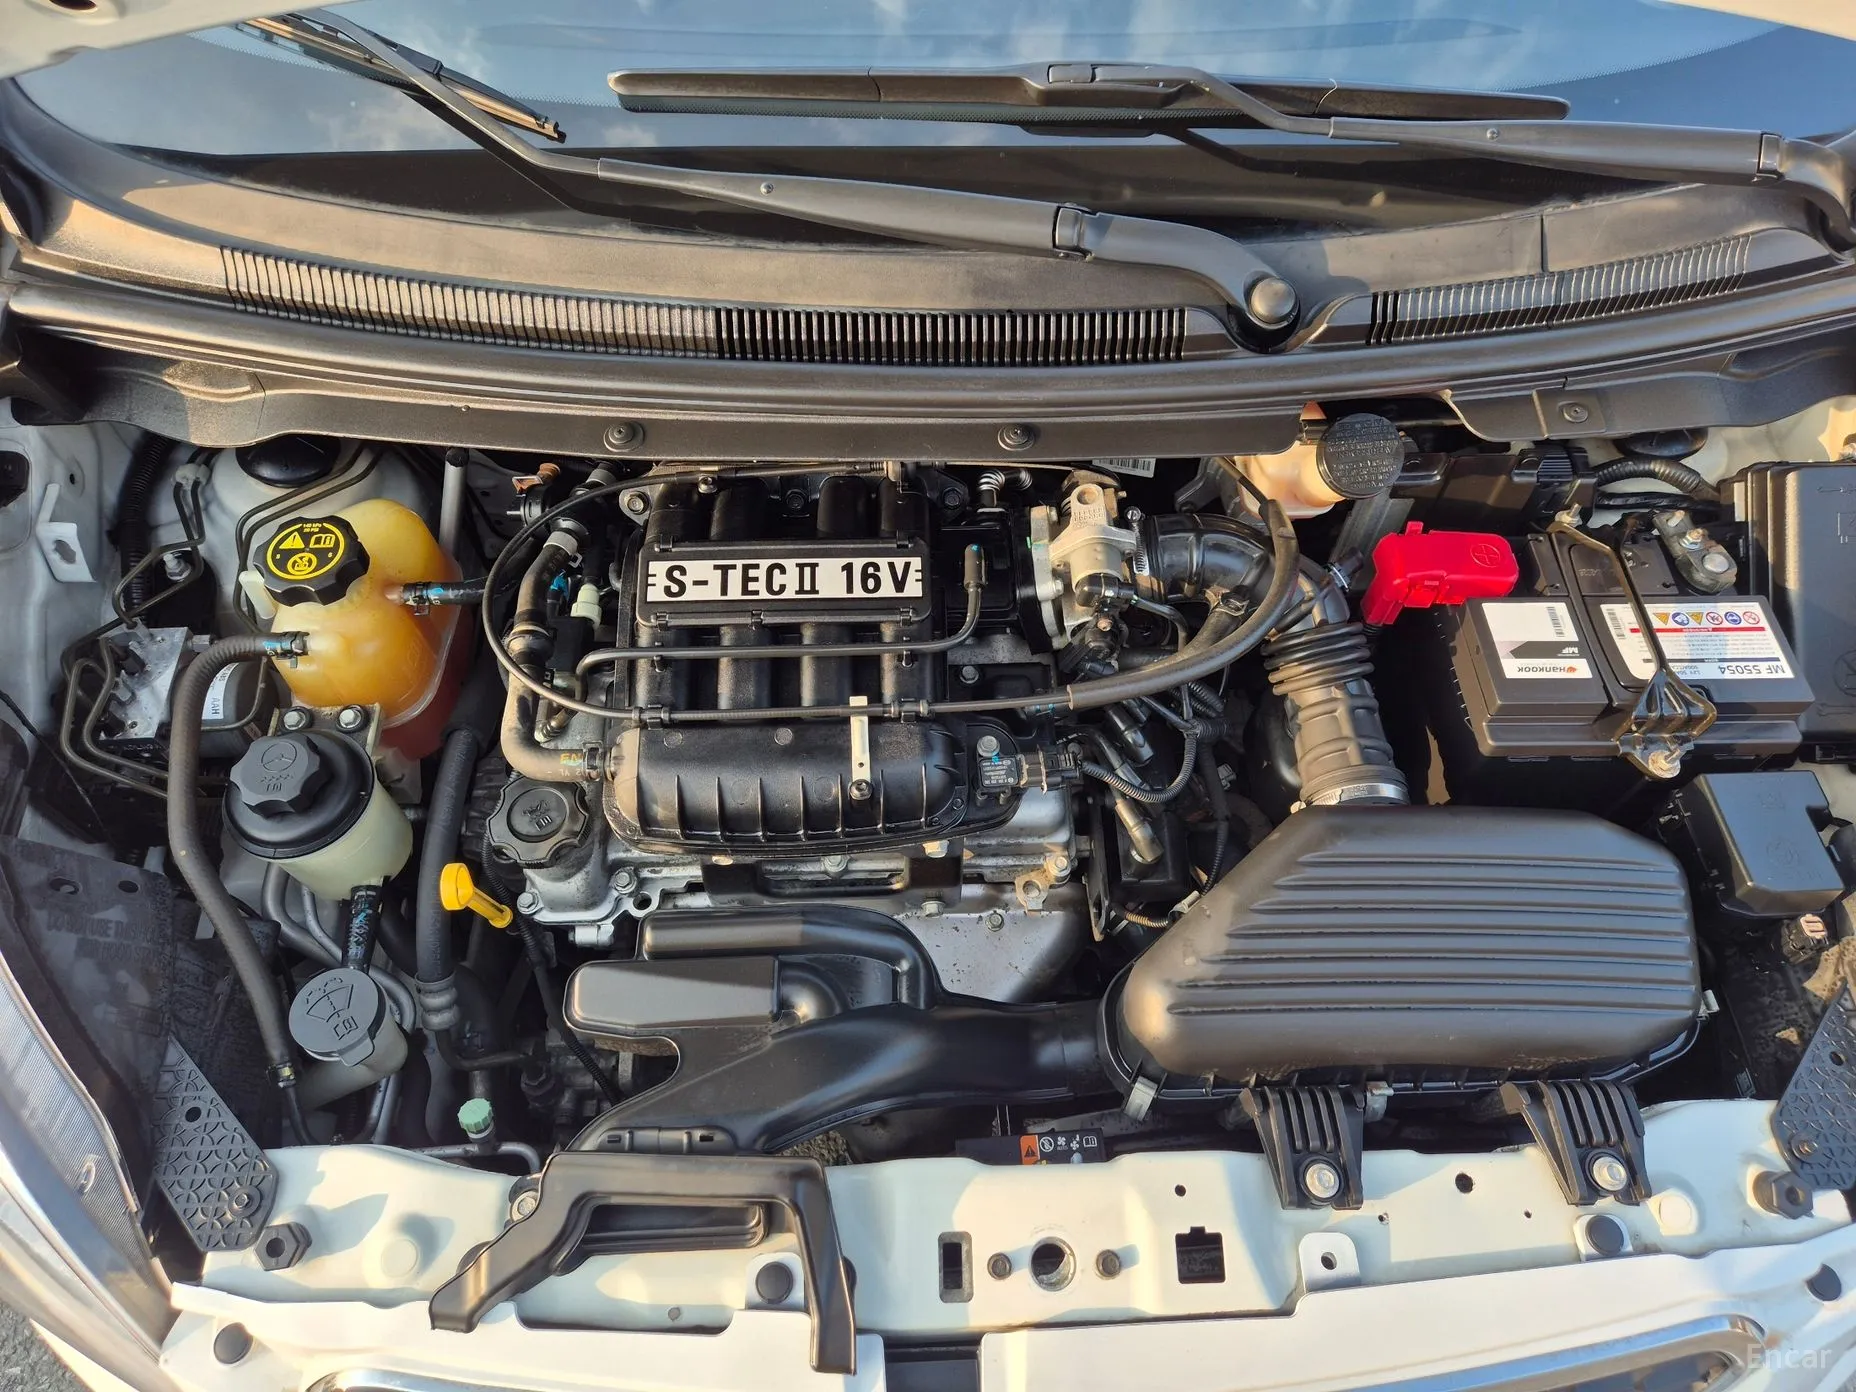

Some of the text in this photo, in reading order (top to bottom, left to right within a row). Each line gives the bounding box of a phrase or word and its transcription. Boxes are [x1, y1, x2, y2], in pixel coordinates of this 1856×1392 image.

[840, 561, 912, 595] 16V
[1561, 646, 1579, 654] MF
[1718, 664, 1786, 675] MF 55054
